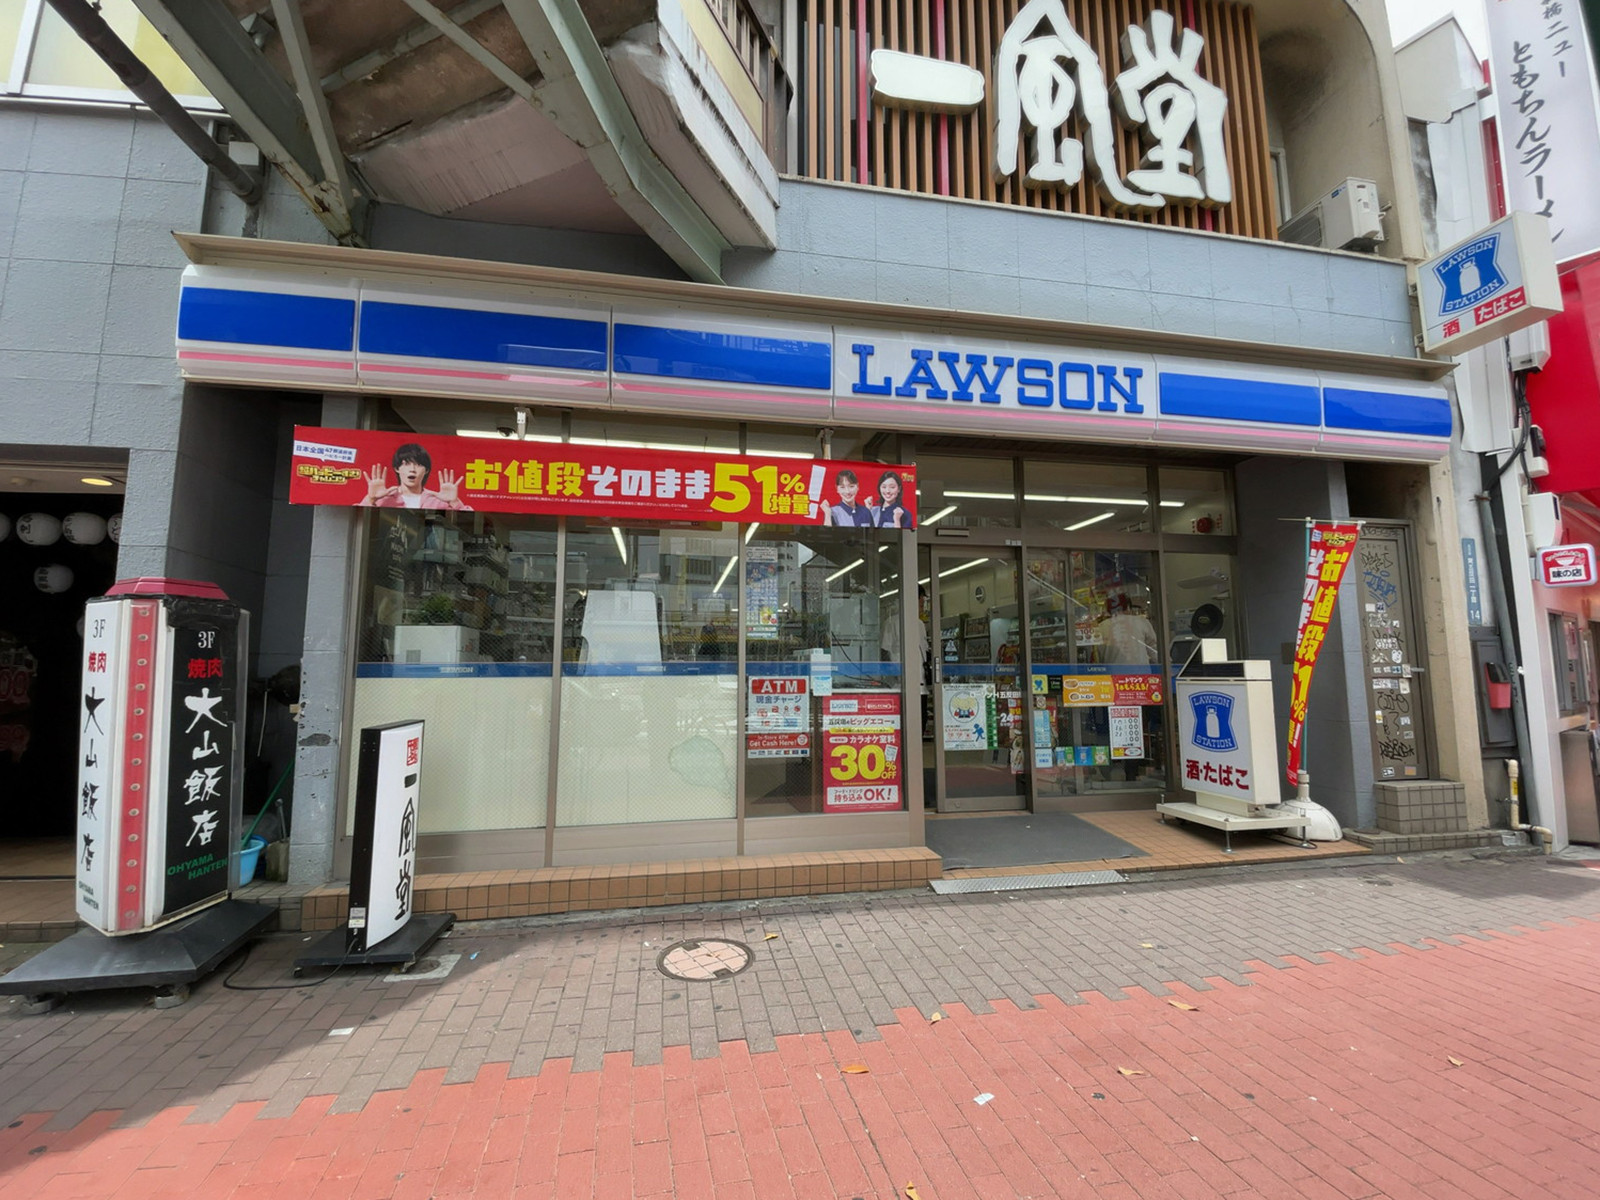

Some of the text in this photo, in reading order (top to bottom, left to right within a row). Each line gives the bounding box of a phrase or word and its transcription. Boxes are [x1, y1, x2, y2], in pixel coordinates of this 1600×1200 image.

[869, 0, 1231, 209] 一風堂
[1439, 239, 1494, 273] LAWSON
[1445, 279, 1500, 311] STATION
[1442, 290, 1523, 338] 酒 たばこ
[852, 344, 1144, 413] LAWSON
[1552, 569, 1582, 578] 味の店
[1298, 549, 1348, 662] お値段
[1470, 610, 1481, 619] 14
[93, 619, 106, 638] 3F
[198, 631, 215, 649] 3F
[88, 651, 107, 673] 焼肉
[188, 659, 223, 679] 焼肉
[761, 681, 797, 693] ATM
[756, 696, 802, 704] 現金チャージ
[1193, 694, 1230, 708] LAWSON
[1196, 735, 1233, 748] STATION
[184, 687, 228, 847] 大山飯店
[80, 687, 105, 872] 大山飯店
[394, 773, 417, 920] 一風堂
[167, 853, 214, 876] OHYAMA
[188, 860, 230, 881] HANTEN
